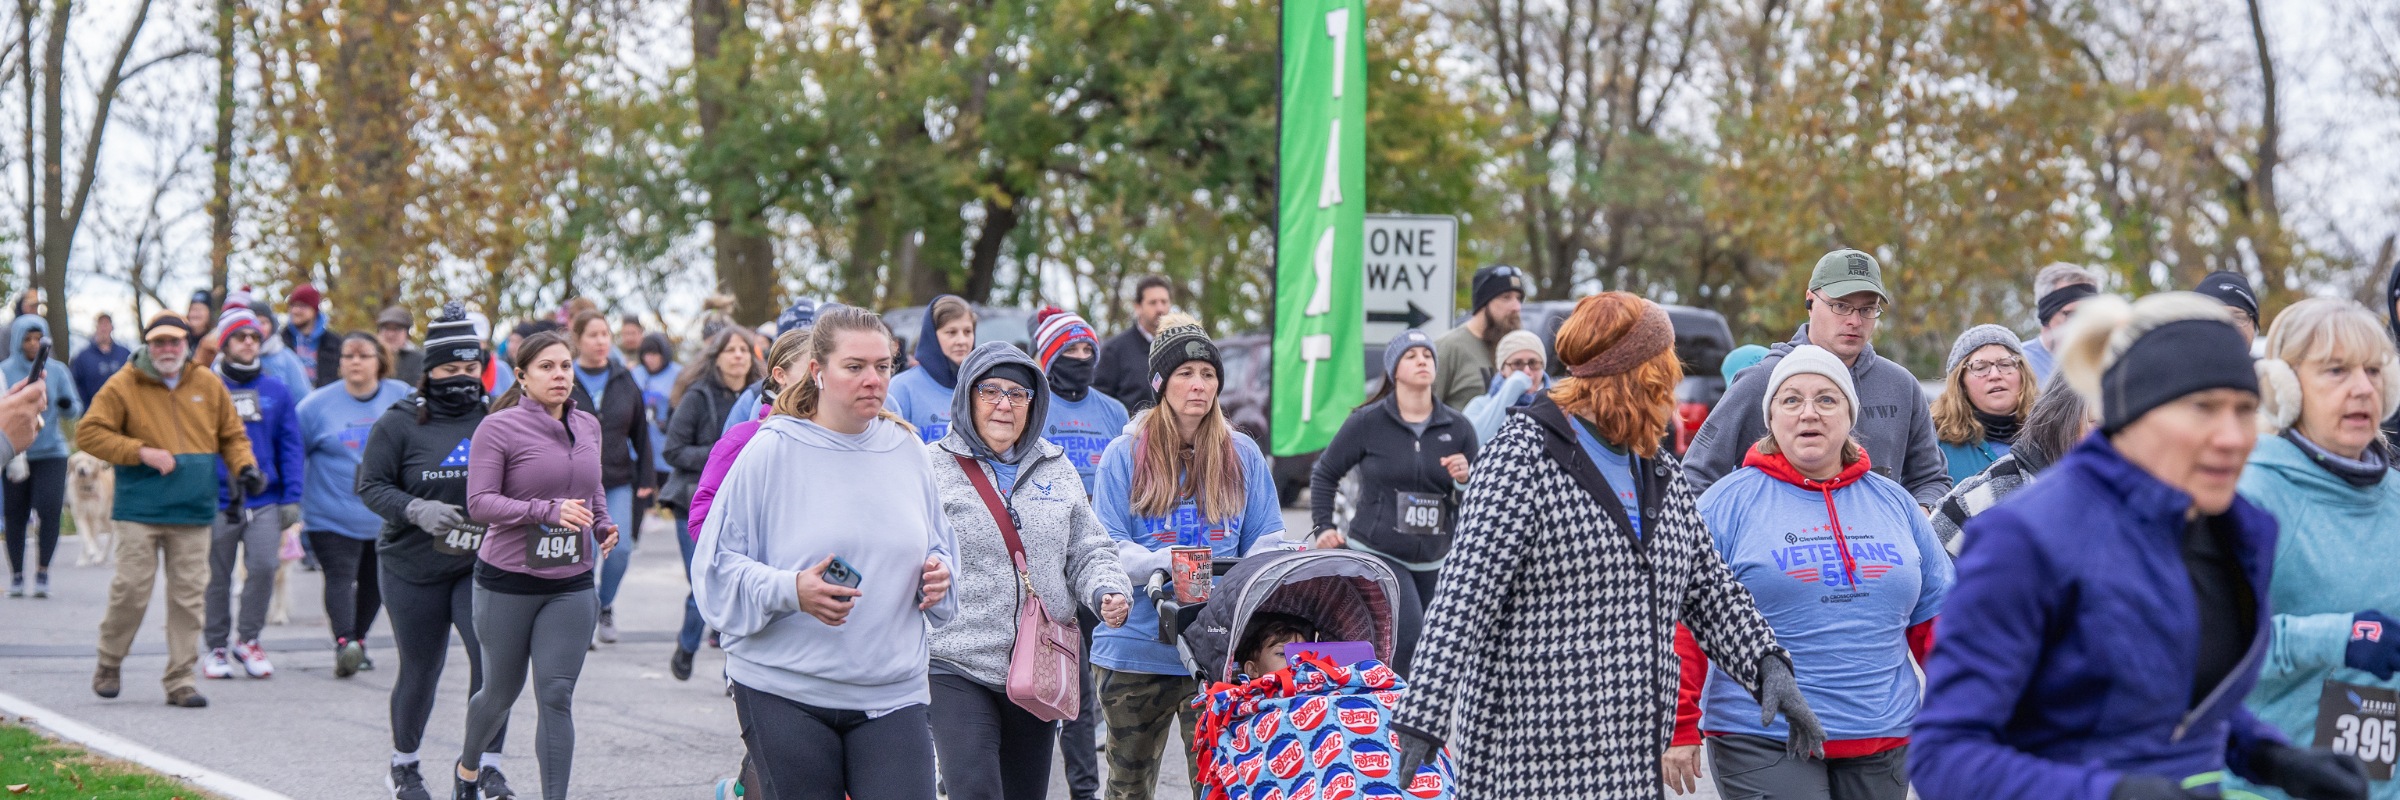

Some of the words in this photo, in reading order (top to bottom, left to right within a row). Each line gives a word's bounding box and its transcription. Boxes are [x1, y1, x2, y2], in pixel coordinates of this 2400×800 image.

[1370, 228, 1436, 258] ONE
[1844, 253, 1869, 261] VETERAN
[1367, 263, 1437, 292] WAY
[1862, 404, 1898, 420] WWP
[1068, 451, 1091, 468] 5K
[422, 470, 460, 481] FOLDS
[1405, 505, 1439, 527] 499
[445, 528, 482, 550] 441
[1179, 526, 1209, 546] 5K
[536, 535, 577, 559] 494
[1188, 553, 1203, 561] When
[1192, 571, 1210, 580] Found
[1822, 563, 1863, 587] 5K
[2332, 713, 2397, 764] 395
